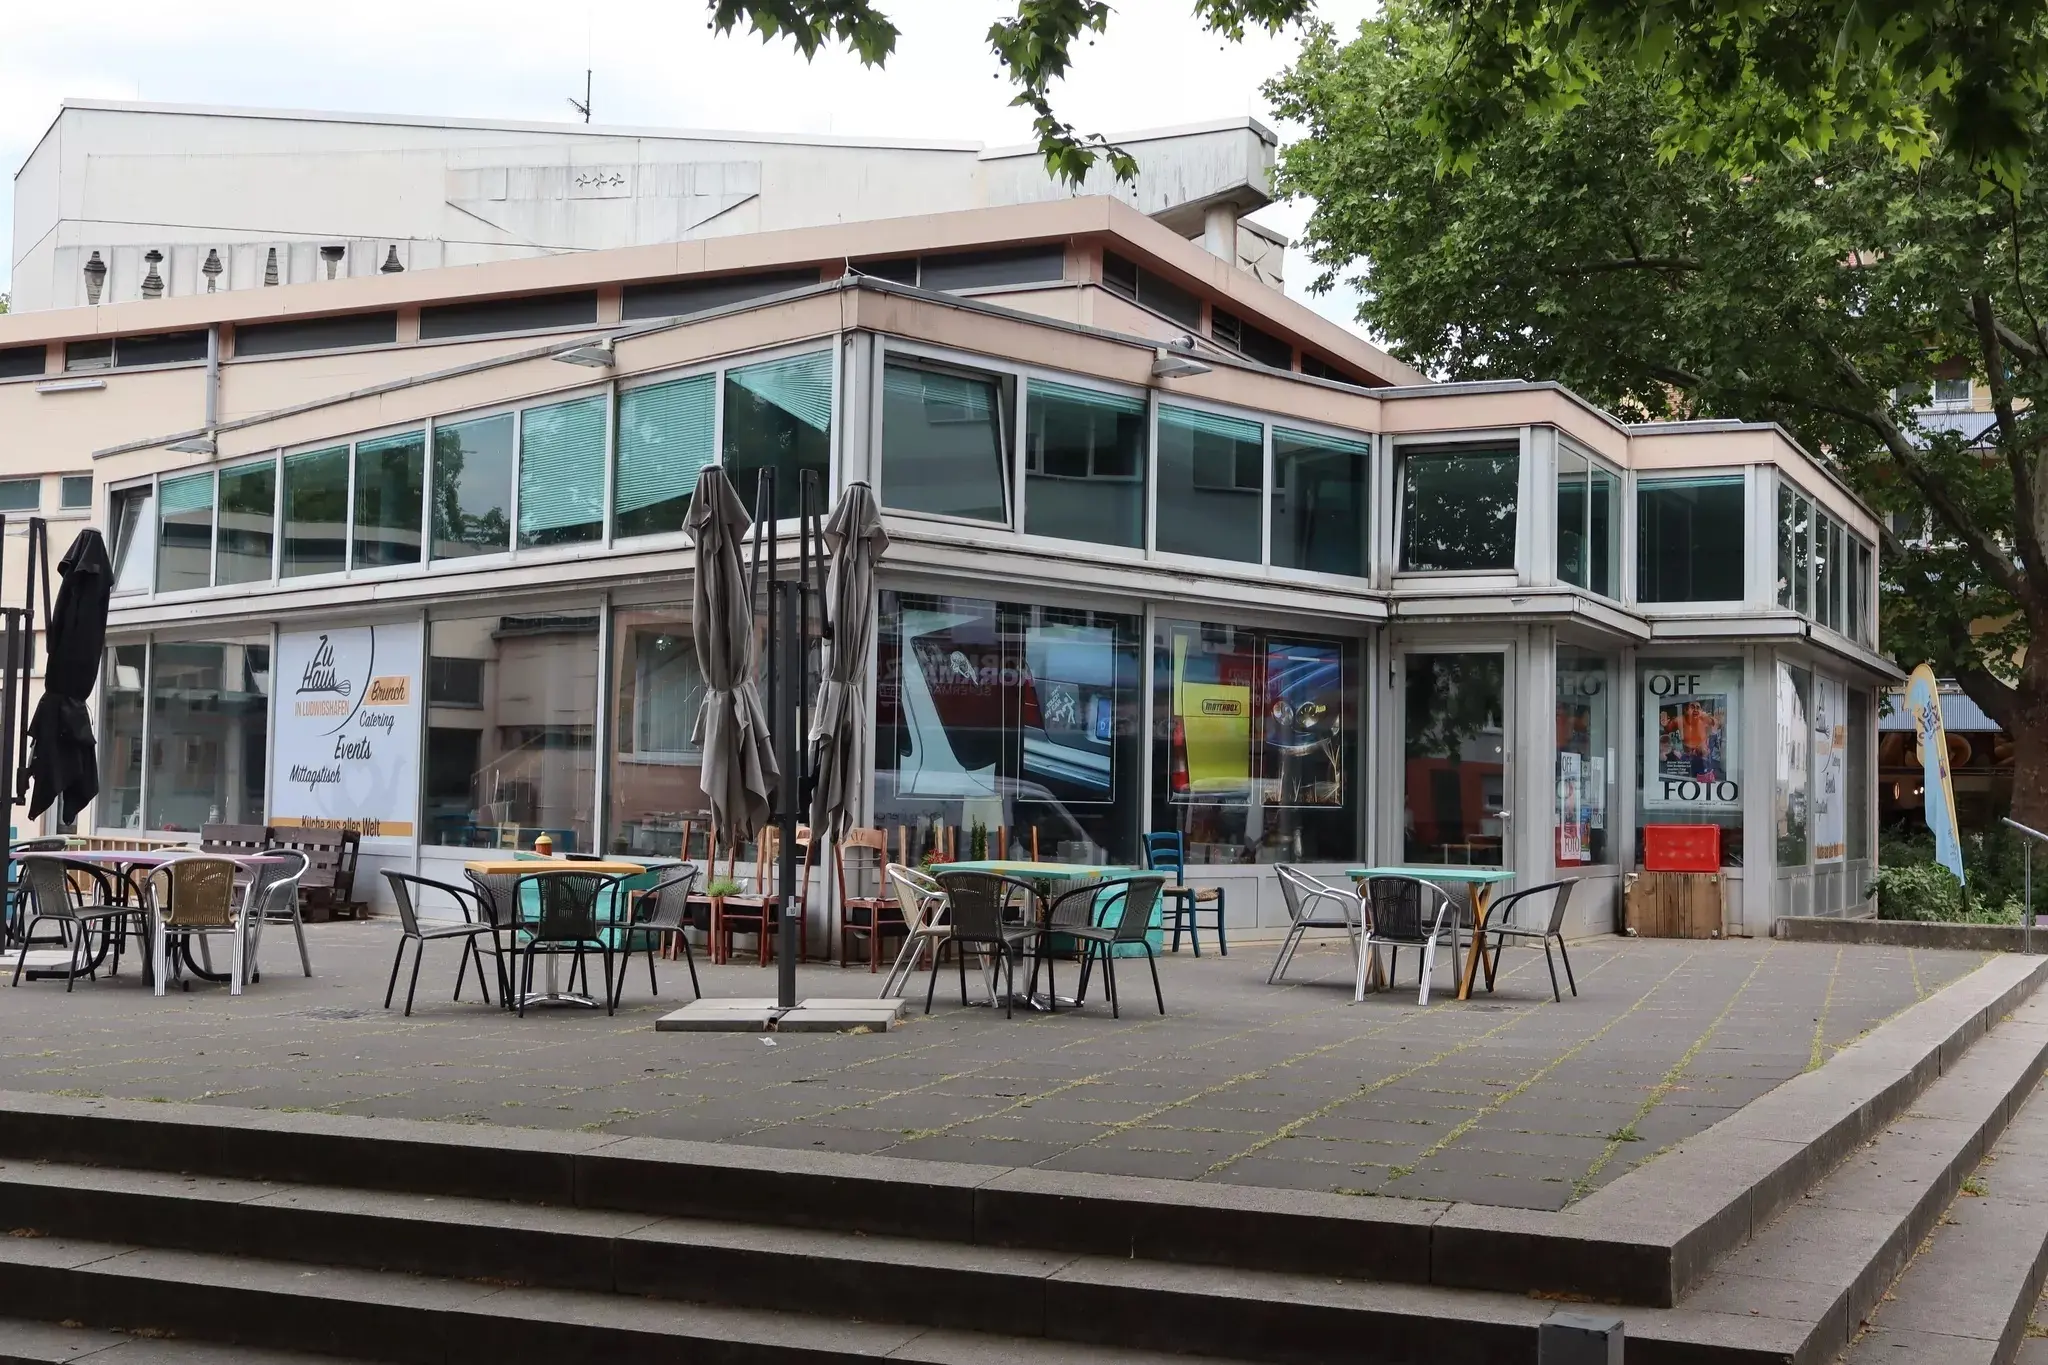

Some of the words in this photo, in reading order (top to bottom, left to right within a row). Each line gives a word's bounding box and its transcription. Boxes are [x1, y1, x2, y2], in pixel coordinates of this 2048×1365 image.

[313, 635, 335, 668] Zu
[302, 661, 338, 689] Haus
[1650, 674, 1701, 697] OFF
[370, 680, 405, 702] Brunch
[295, 701, 302, 717] IN
[302, 700, 350, 717] LUDWIGSHAFEN
[359, 710, 395, 735] Catering
[334, 734, 373, 760] Events
[289, 764, 341, 792] Mittagstisch
[1664, 781, 1739, 802] FOTO
[363, 817, 381, 837] Welt
